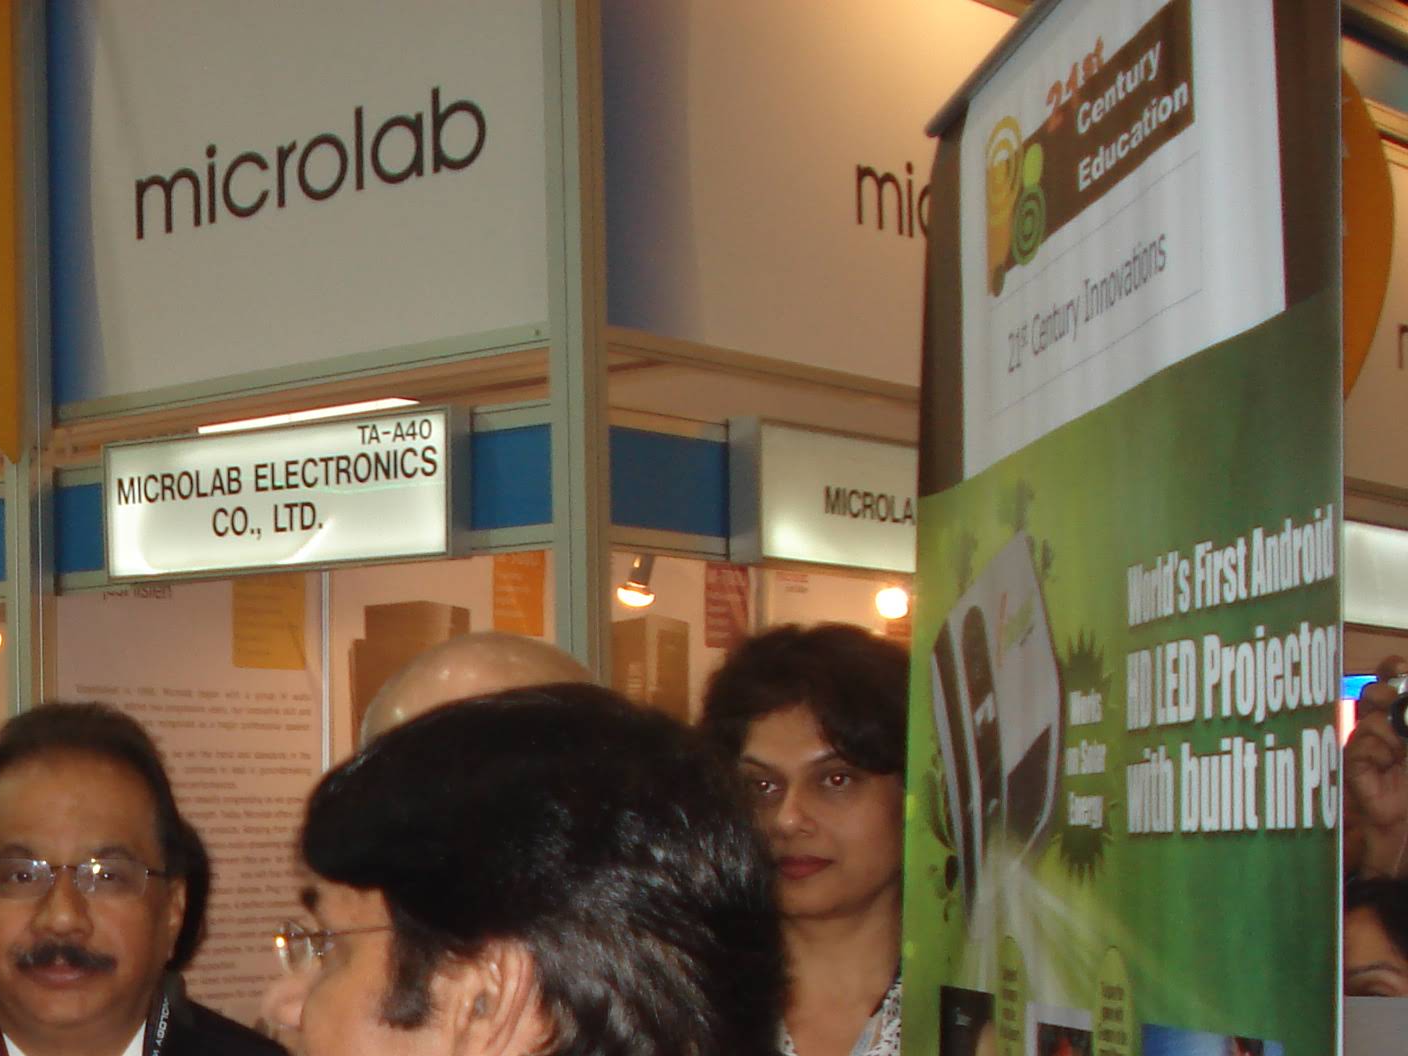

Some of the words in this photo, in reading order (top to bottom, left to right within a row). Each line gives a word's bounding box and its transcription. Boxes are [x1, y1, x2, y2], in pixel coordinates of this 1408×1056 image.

[1076, 40, 1161, 135] Century
[1078, 81, 1189, 192] Education
[135, 86, 486, 240] microlab
[1031, 295, 1080, 356] Century
[1084, 233, 1166, 323] Innovations
[116, 466, 242, 506] MICROLAB
[254, 445, 438, 492] ELECTRONICS
[356, 418, 432, 445] TA-A40
[212, 506, 263, 540] CO.,
[273, 501, 324, 533] LTD.
[1195, 536, 1248, 609] First
[1250, 503, 1335, 597] Android
[1155, 639, 1197, 726] LED
[1203, 621, 1337, 723] Projector
[1127, 744, 1174, 834] with
[1180, 736, 1258, 834] built
[1264, 732, 1296, 830] in
